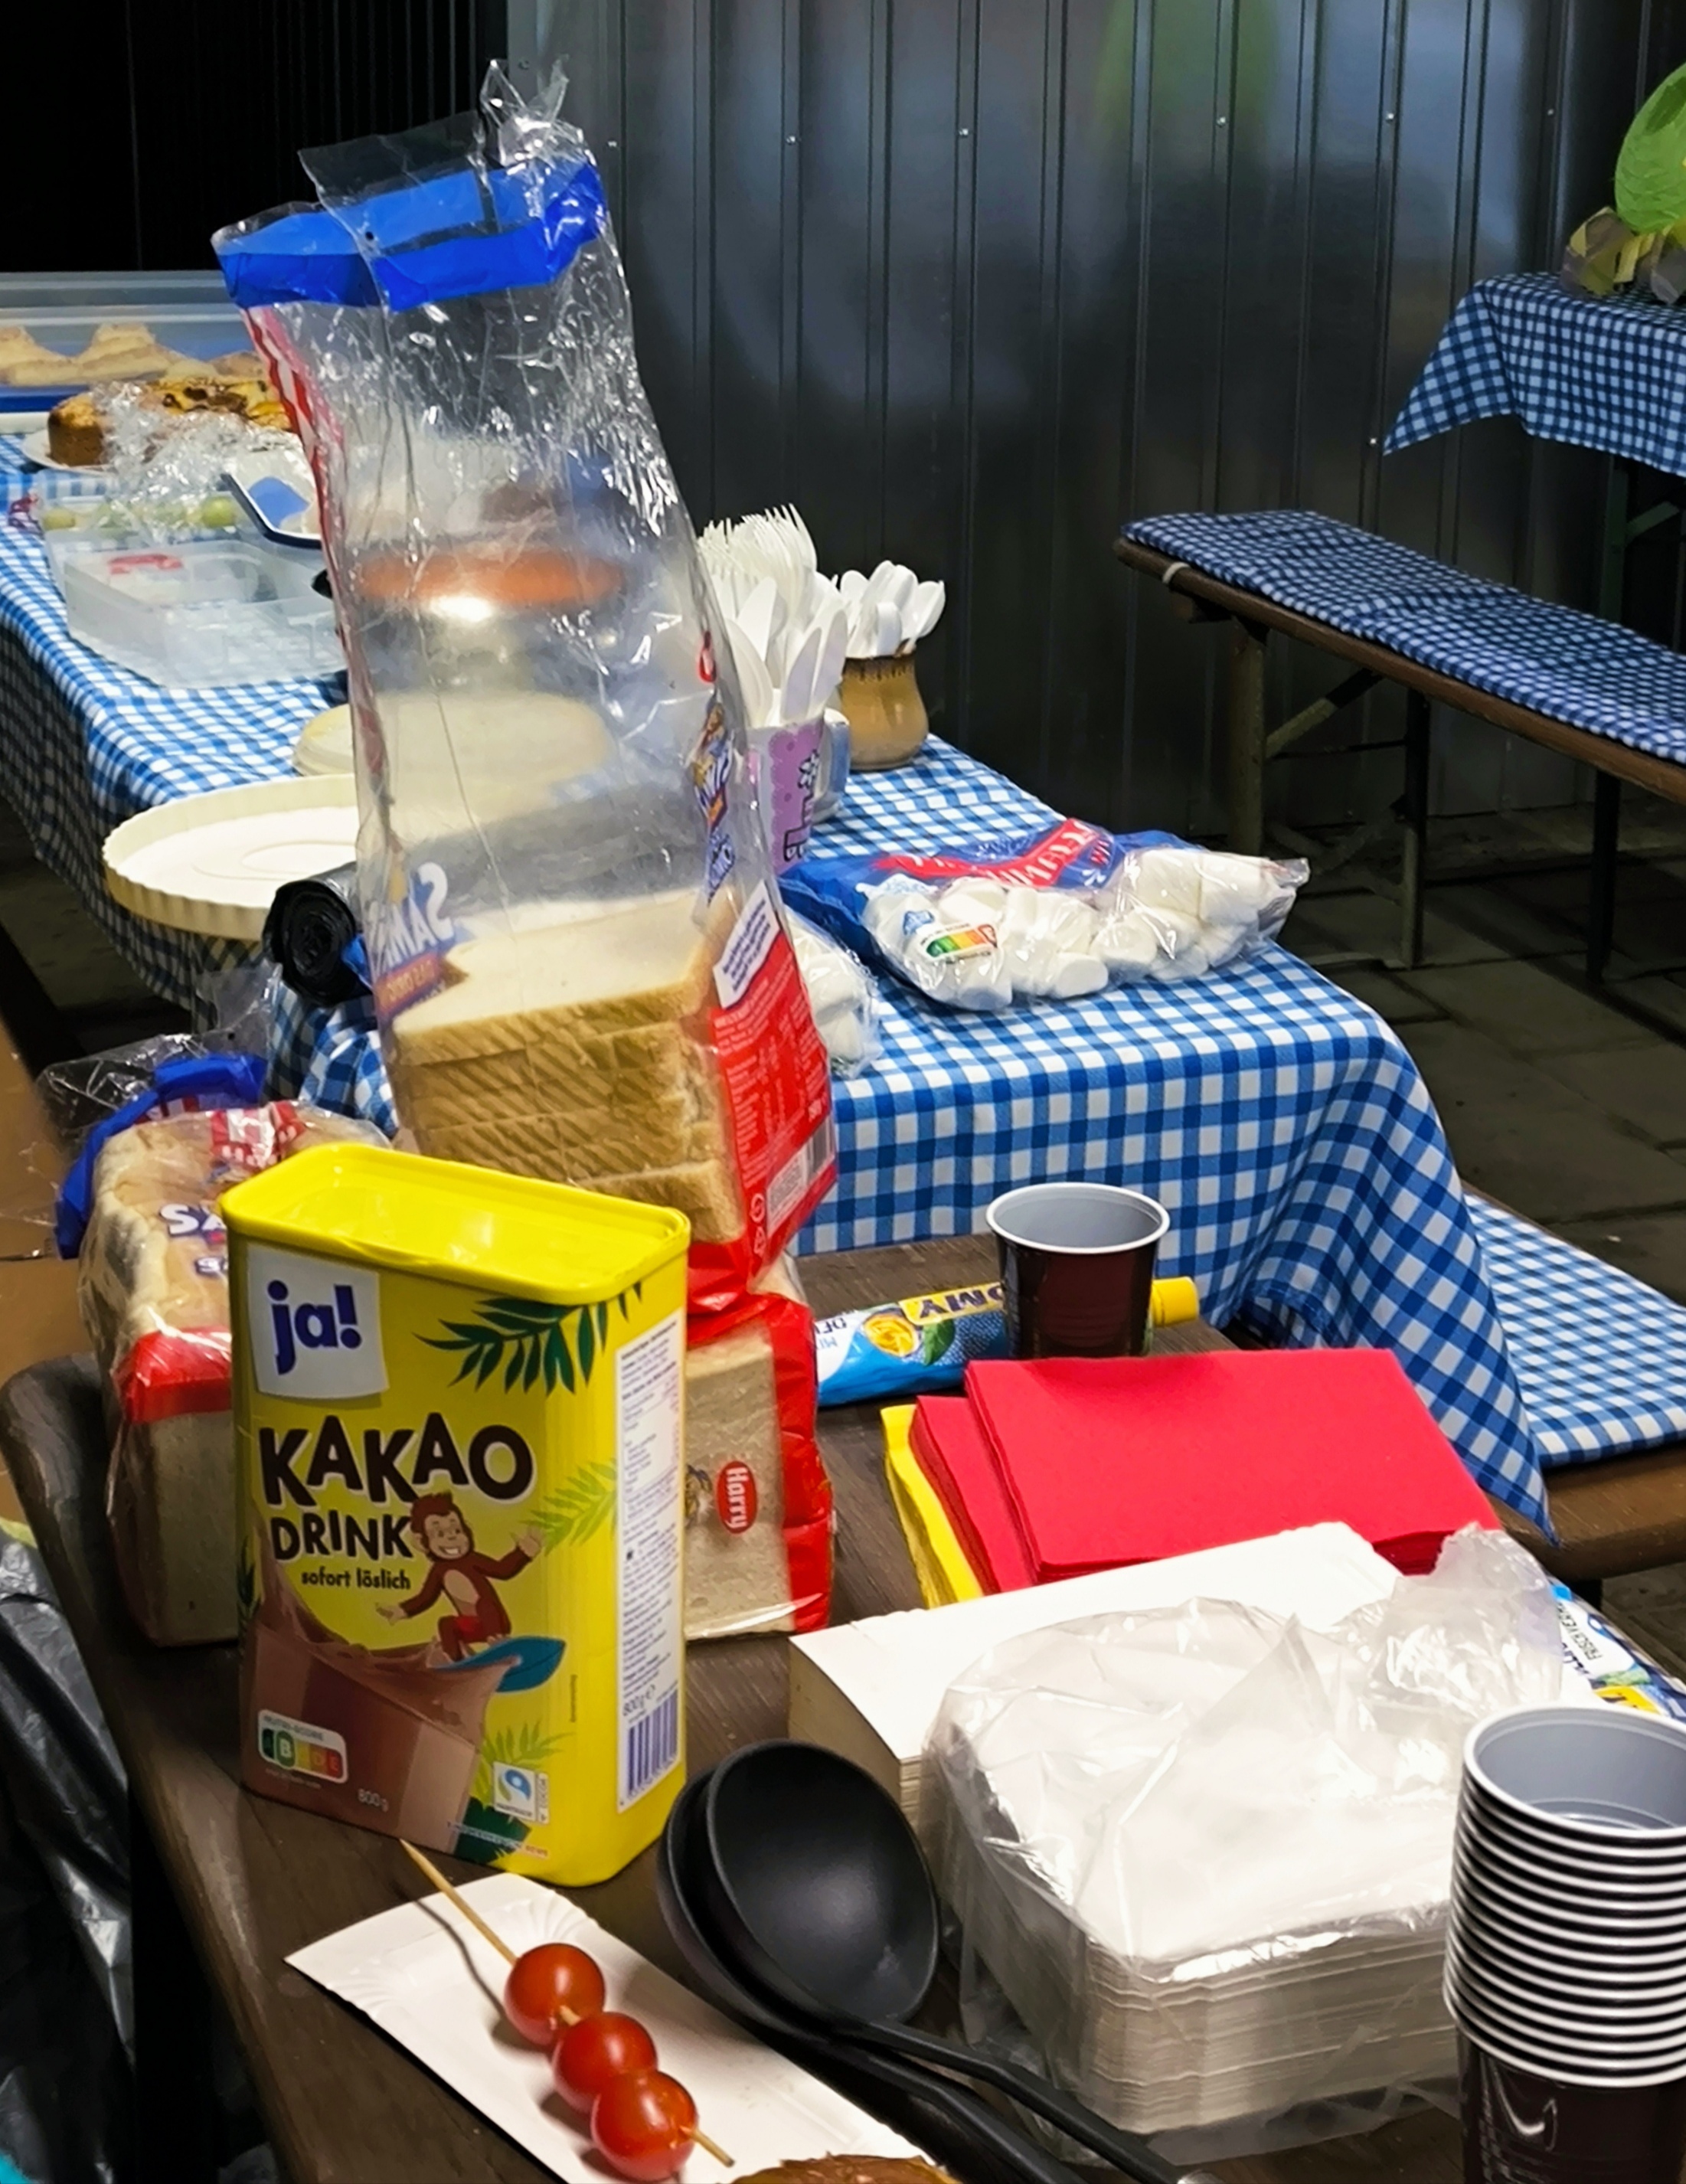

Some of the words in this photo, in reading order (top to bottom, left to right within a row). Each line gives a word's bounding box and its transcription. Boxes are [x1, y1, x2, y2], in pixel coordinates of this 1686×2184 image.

[267, 1280, 362, 1375] ja!
[258, 1412, 534, 1507] KAKAO
[724, 1466, 750, 1529] Harry
[273, 1511, 413, 1561] DRINK
[301, 1567, 350, 1588] sofort
[357, 1567, 412, 1591] löslich
